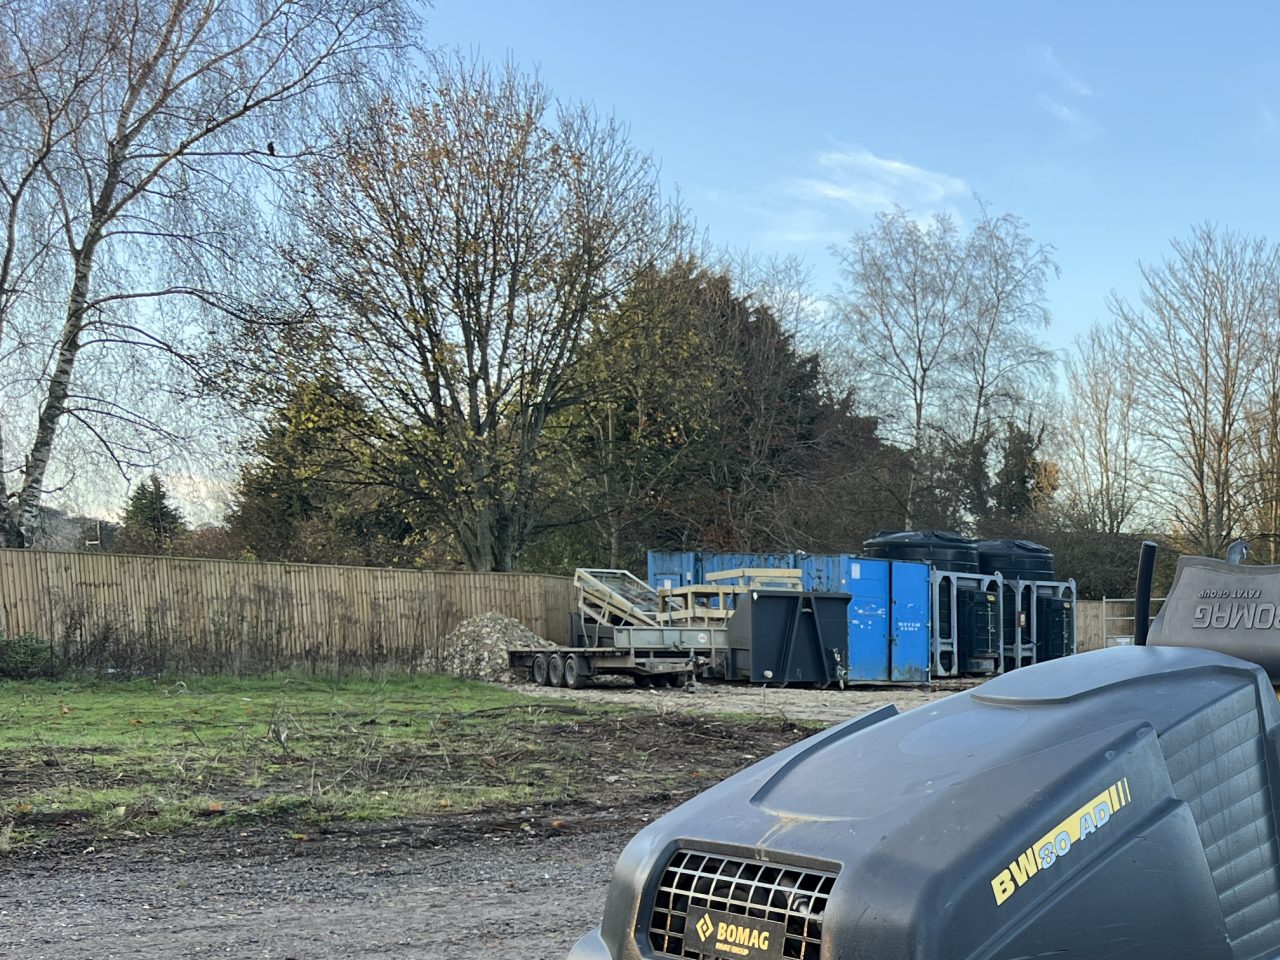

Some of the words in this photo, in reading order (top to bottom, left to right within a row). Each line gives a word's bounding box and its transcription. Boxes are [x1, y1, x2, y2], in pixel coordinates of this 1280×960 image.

[1198, 588, 1230, 599] GROUP
[1231, 589, 1262, 599] FAYAT
[1080, 800, 1112, 841] AD
[716, 921, 770, 951] BOMAG
